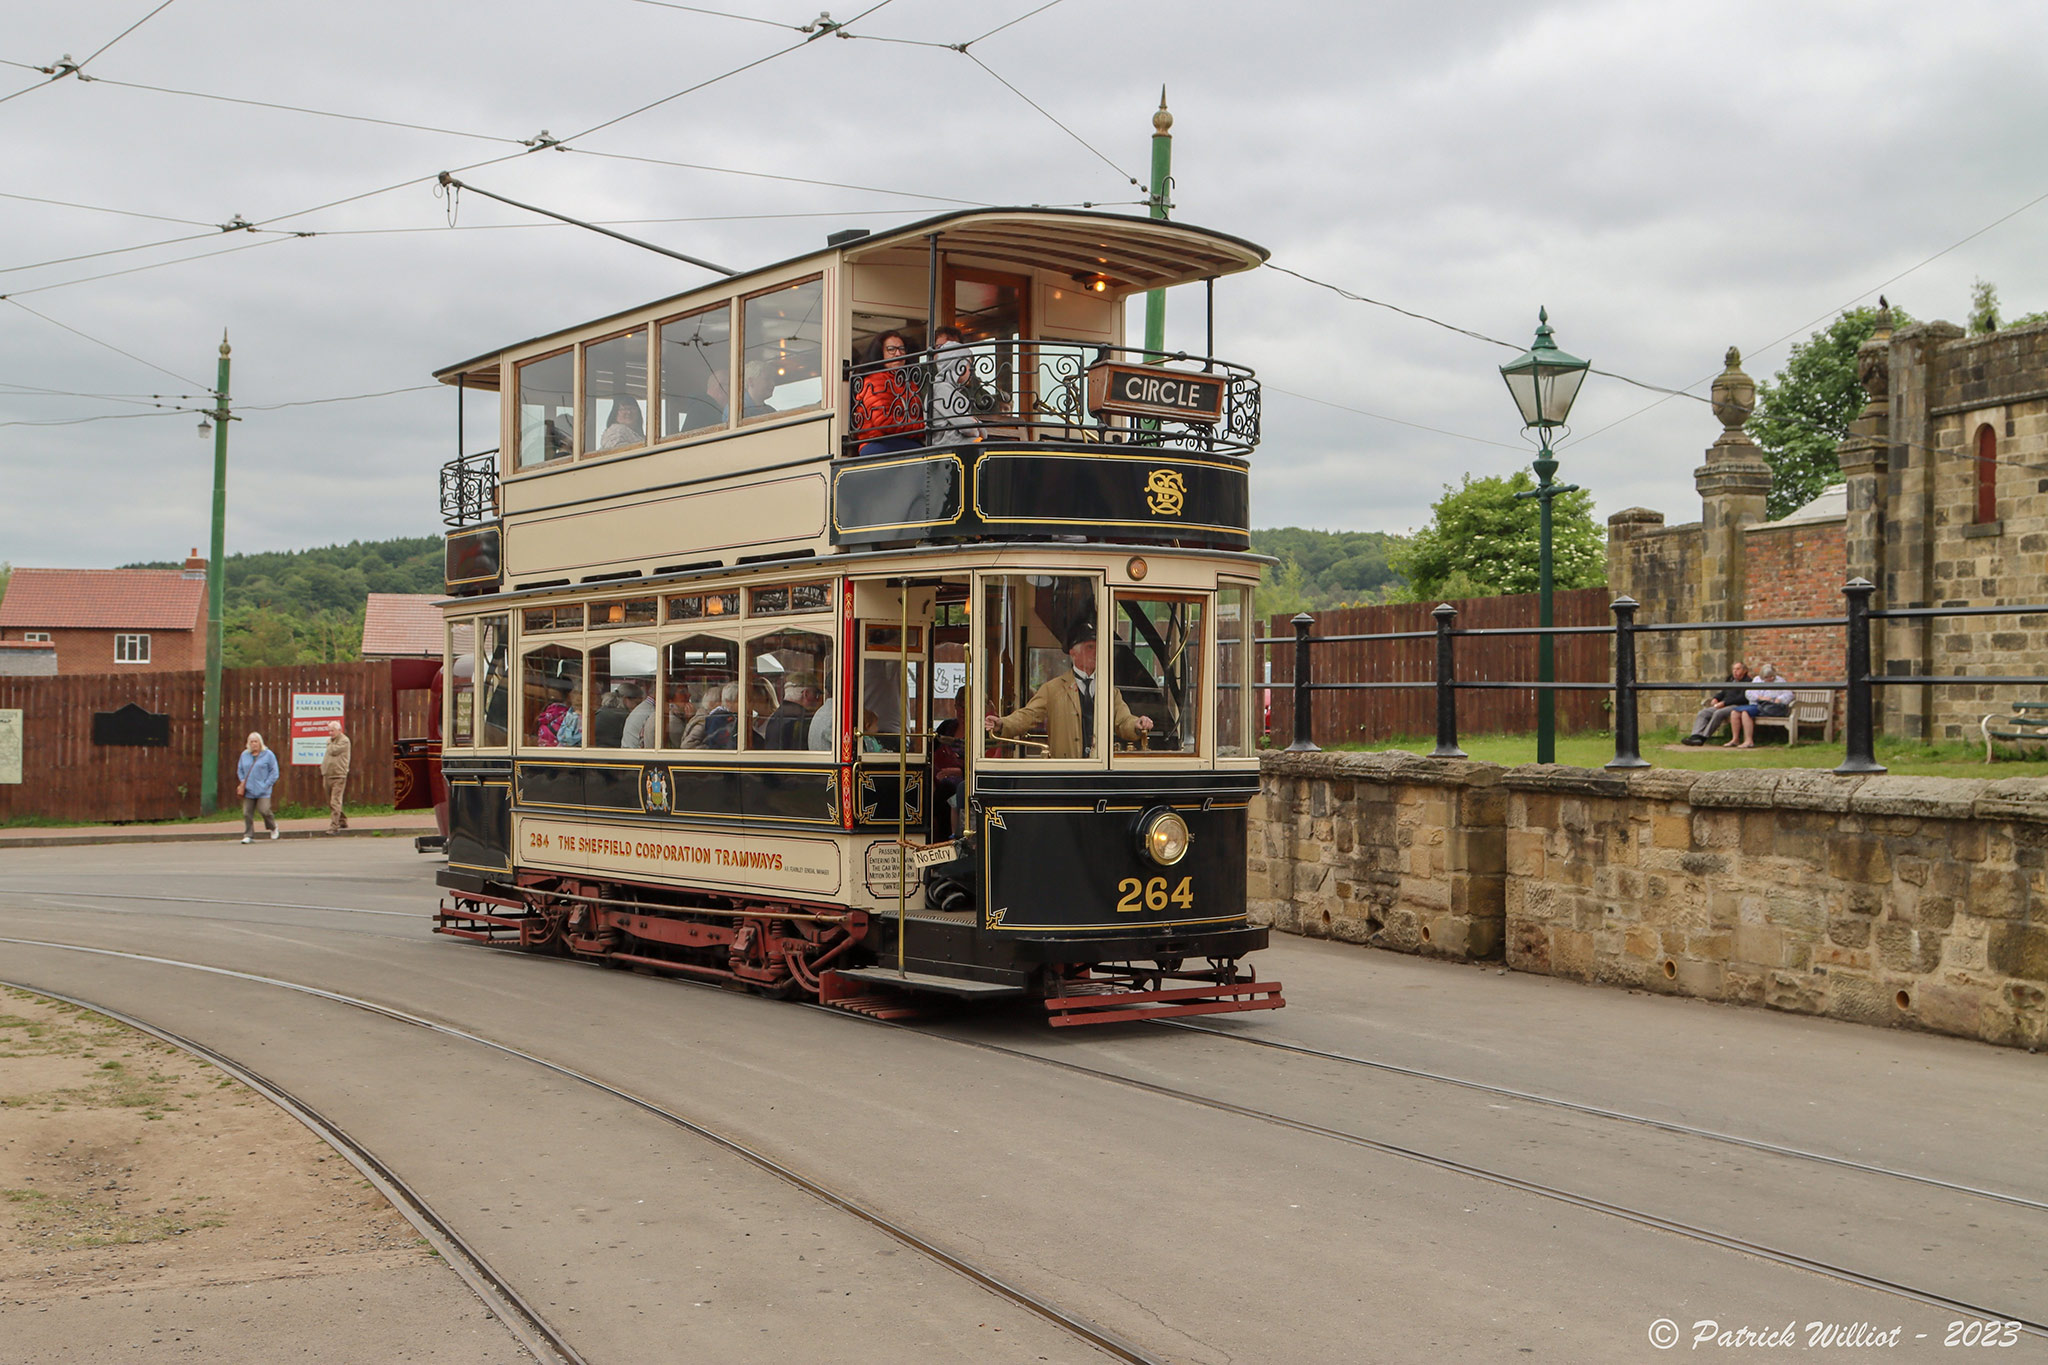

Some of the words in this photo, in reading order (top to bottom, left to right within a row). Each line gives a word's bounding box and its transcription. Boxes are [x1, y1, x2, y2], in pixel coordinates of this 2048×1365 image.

[1125, 377, 1200, 407] CIRCLE
[558, 835, 575, 851] THE
[578, 837, 632, 857] SHEFFIELD
[636, 842, 711, 864] CORPORATION
[715, 848, 782, 871] TRAMWAYS
[878, 847, 906, 855] PASSENG
[916, 852, 928, 864] No
[929, 849, 951, 861] Entry
[1117, 876, 1194, 912] 264
